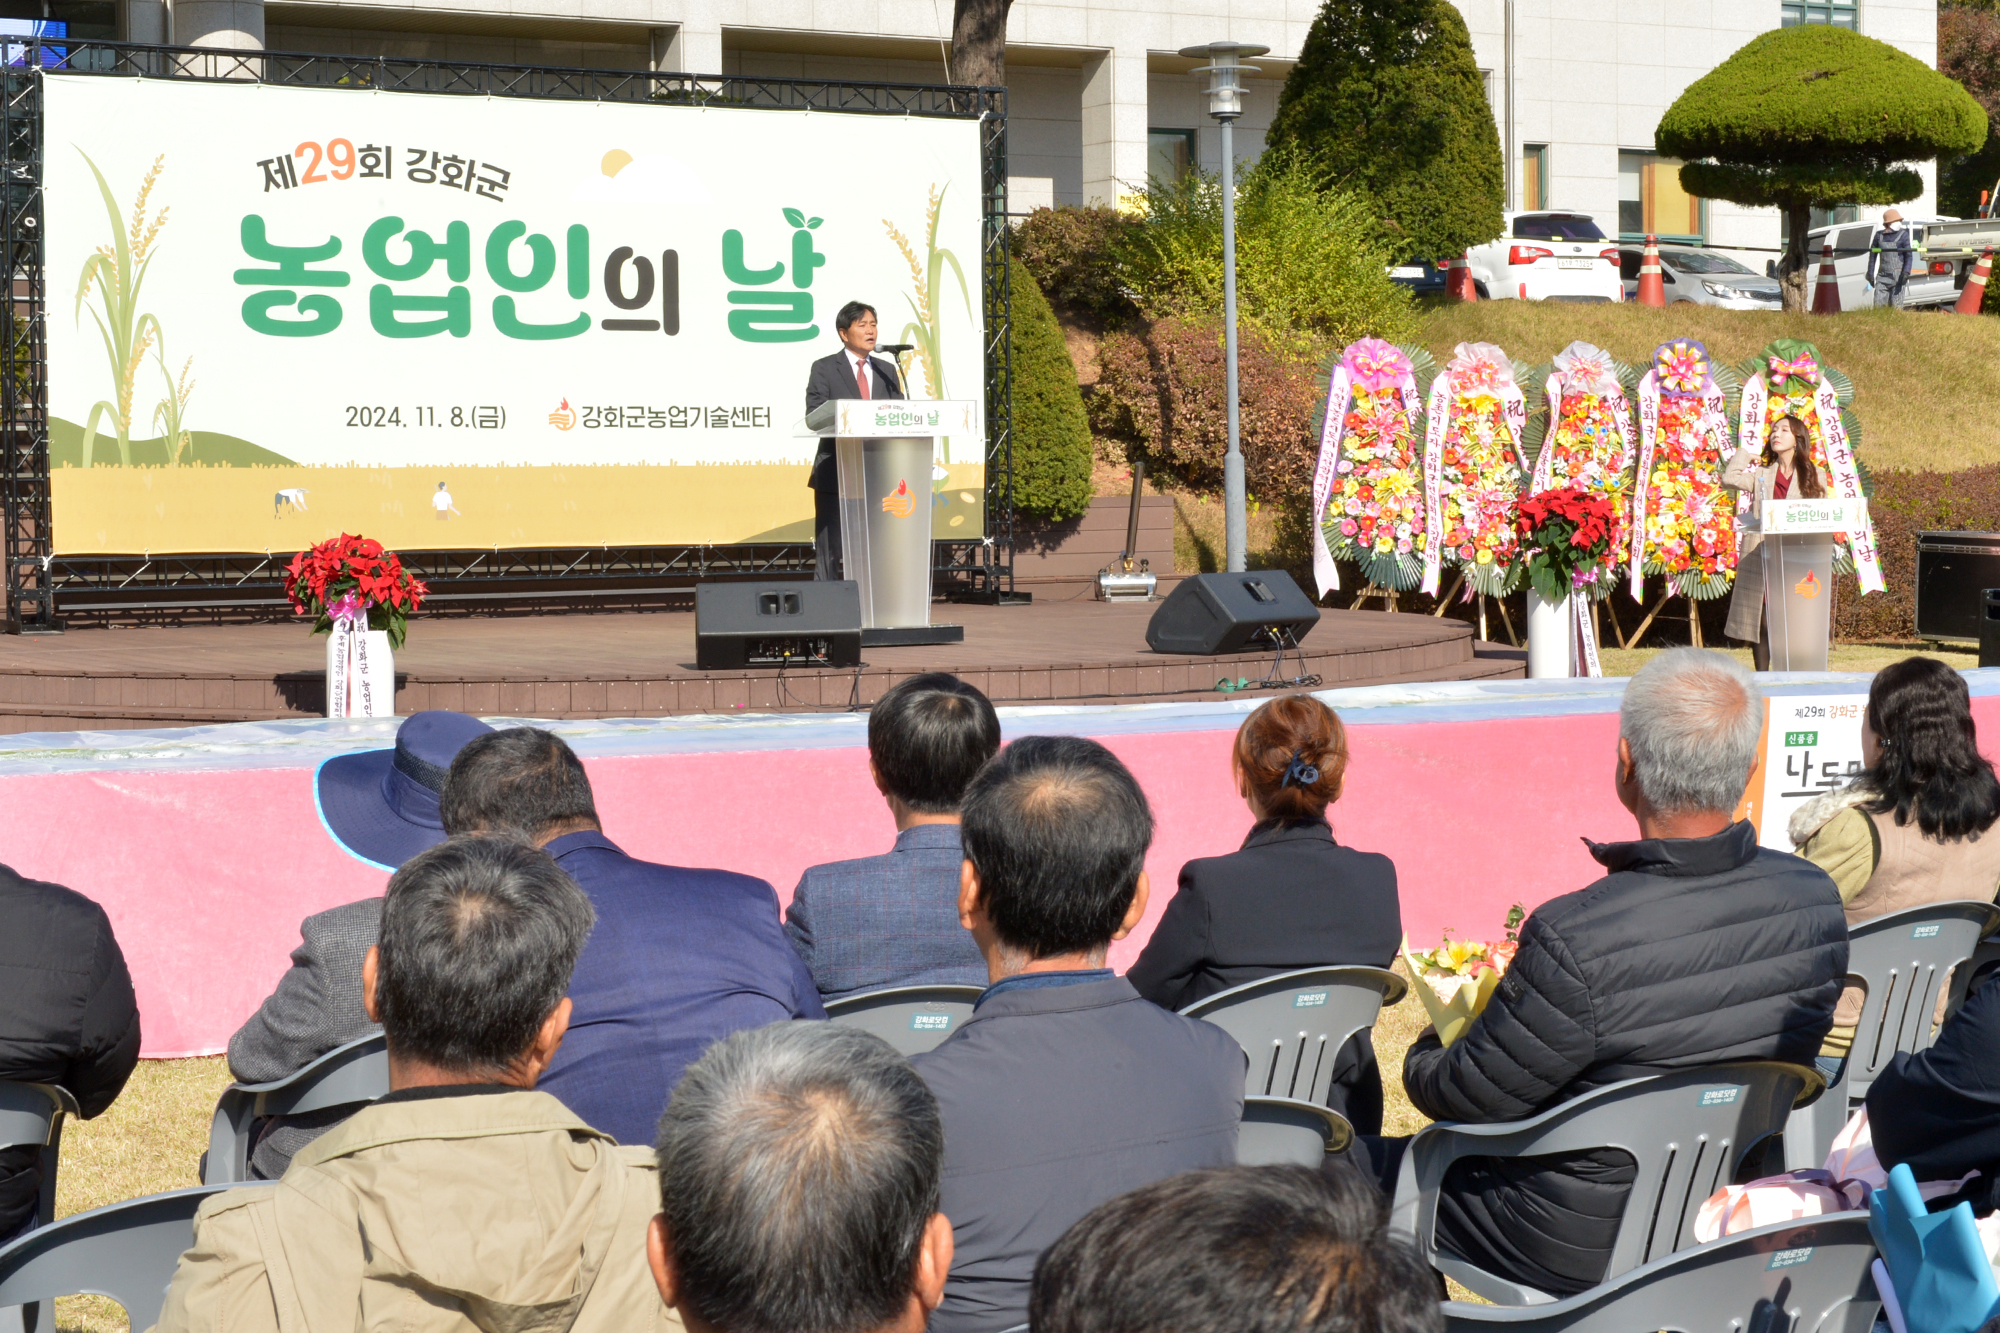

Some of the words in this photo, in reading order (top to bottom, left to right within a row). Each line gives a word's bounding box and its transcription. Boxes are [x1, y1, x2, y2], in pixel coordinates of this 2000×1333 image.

[257, 138, 393, 193] 제29회
[405, 148, 511, 203] 강화군
[233, 213, 680, 341] 농업인의
[721, 220, 826, 343] 날
[1506, 399, 1524, 418] 祝
[1610, 395, 1628, 413] 祝
[1708, 396, 1724, 414] 祝
[1820, 393, 1836, 410] 祝
[345, 406, 408, 428] 2024.
[416, 406, 442, 428] 11.
[451, 406, 507, 430] 8.(금)
[581, 405, 771, 429] 강화군농업기술센터
[875, 412, 923, 426] 농업인의
[927, 410, 939, 426] 날
[1430, 391, 1447, 447] 농촌지도자
[1642, 395, 1656, 439] 강화군
[1743, 393, 1762, 446] 강화군
[1825, 415, 1850, 465] 강화군
[1786, 510, 1829, 523] 농업인의
[1833, 507, 1843, 522] 날
[1858, 544, 1874, 563] 날
[1795, 704, 1826, 719] 제29회
[1829, 703, 1859, 719] 강화군
[1789, 732, 1815, 746] 신품종
[915, 1016, 949, 1024] 강화로닷컴
[1704, 1089, 1738, 1100] 강화로닷컴
[1774, 1247, 1813, 1262] 강화로닷컴
